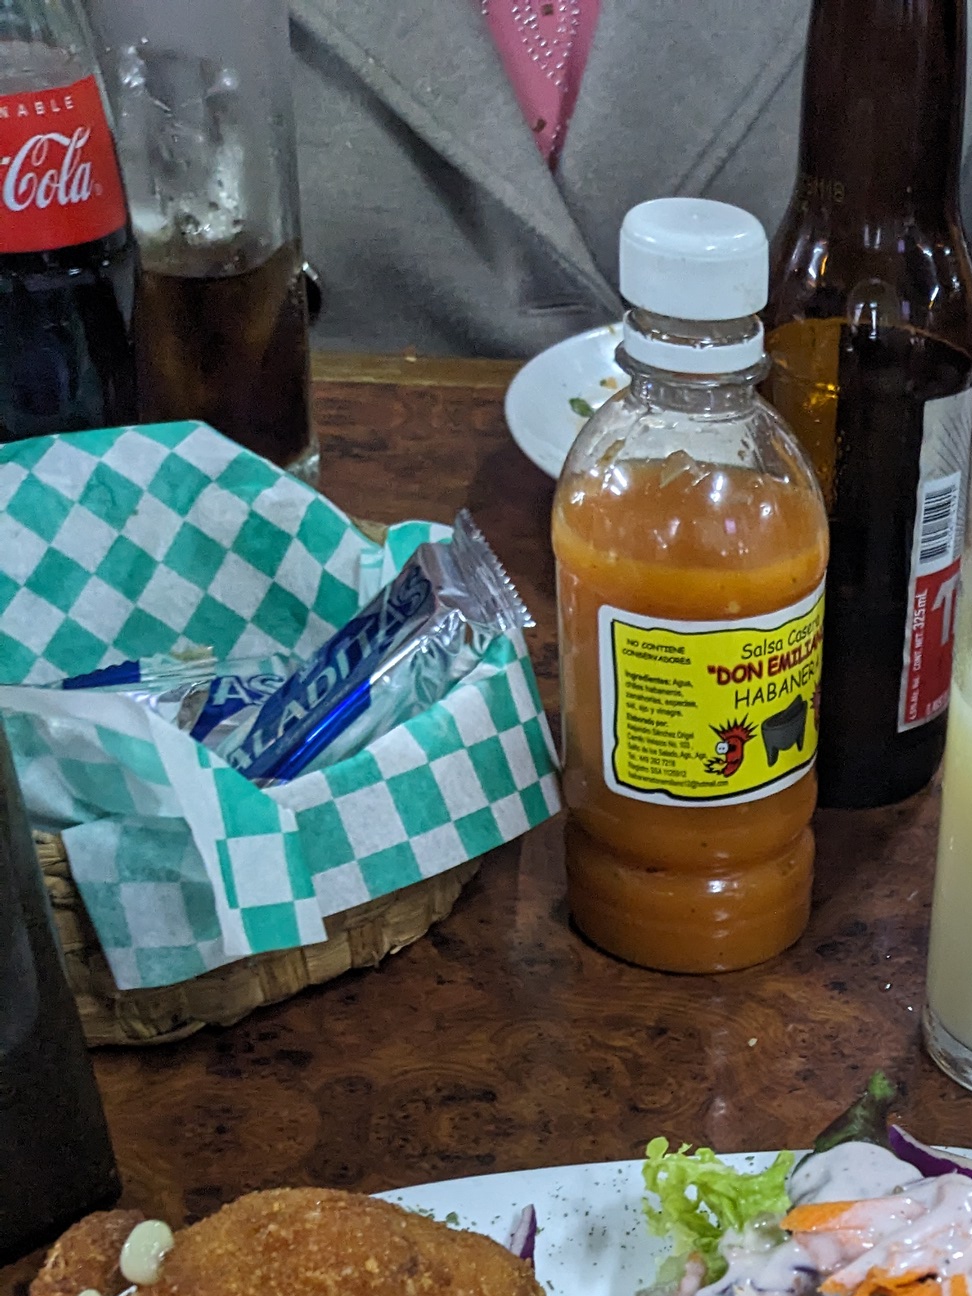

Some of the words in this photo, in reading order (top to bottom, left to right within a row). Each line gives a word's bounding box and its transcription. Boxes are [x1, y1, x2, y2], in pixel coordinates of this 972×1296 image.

[913, 609, 926, 631] 325
[627, 638, 639, 647] NO
[641, 642, 686, 655] CONTIENE
[741, 638, 783, 660] Salsa
[622, 648, 692, 666] CONSERVADORES
